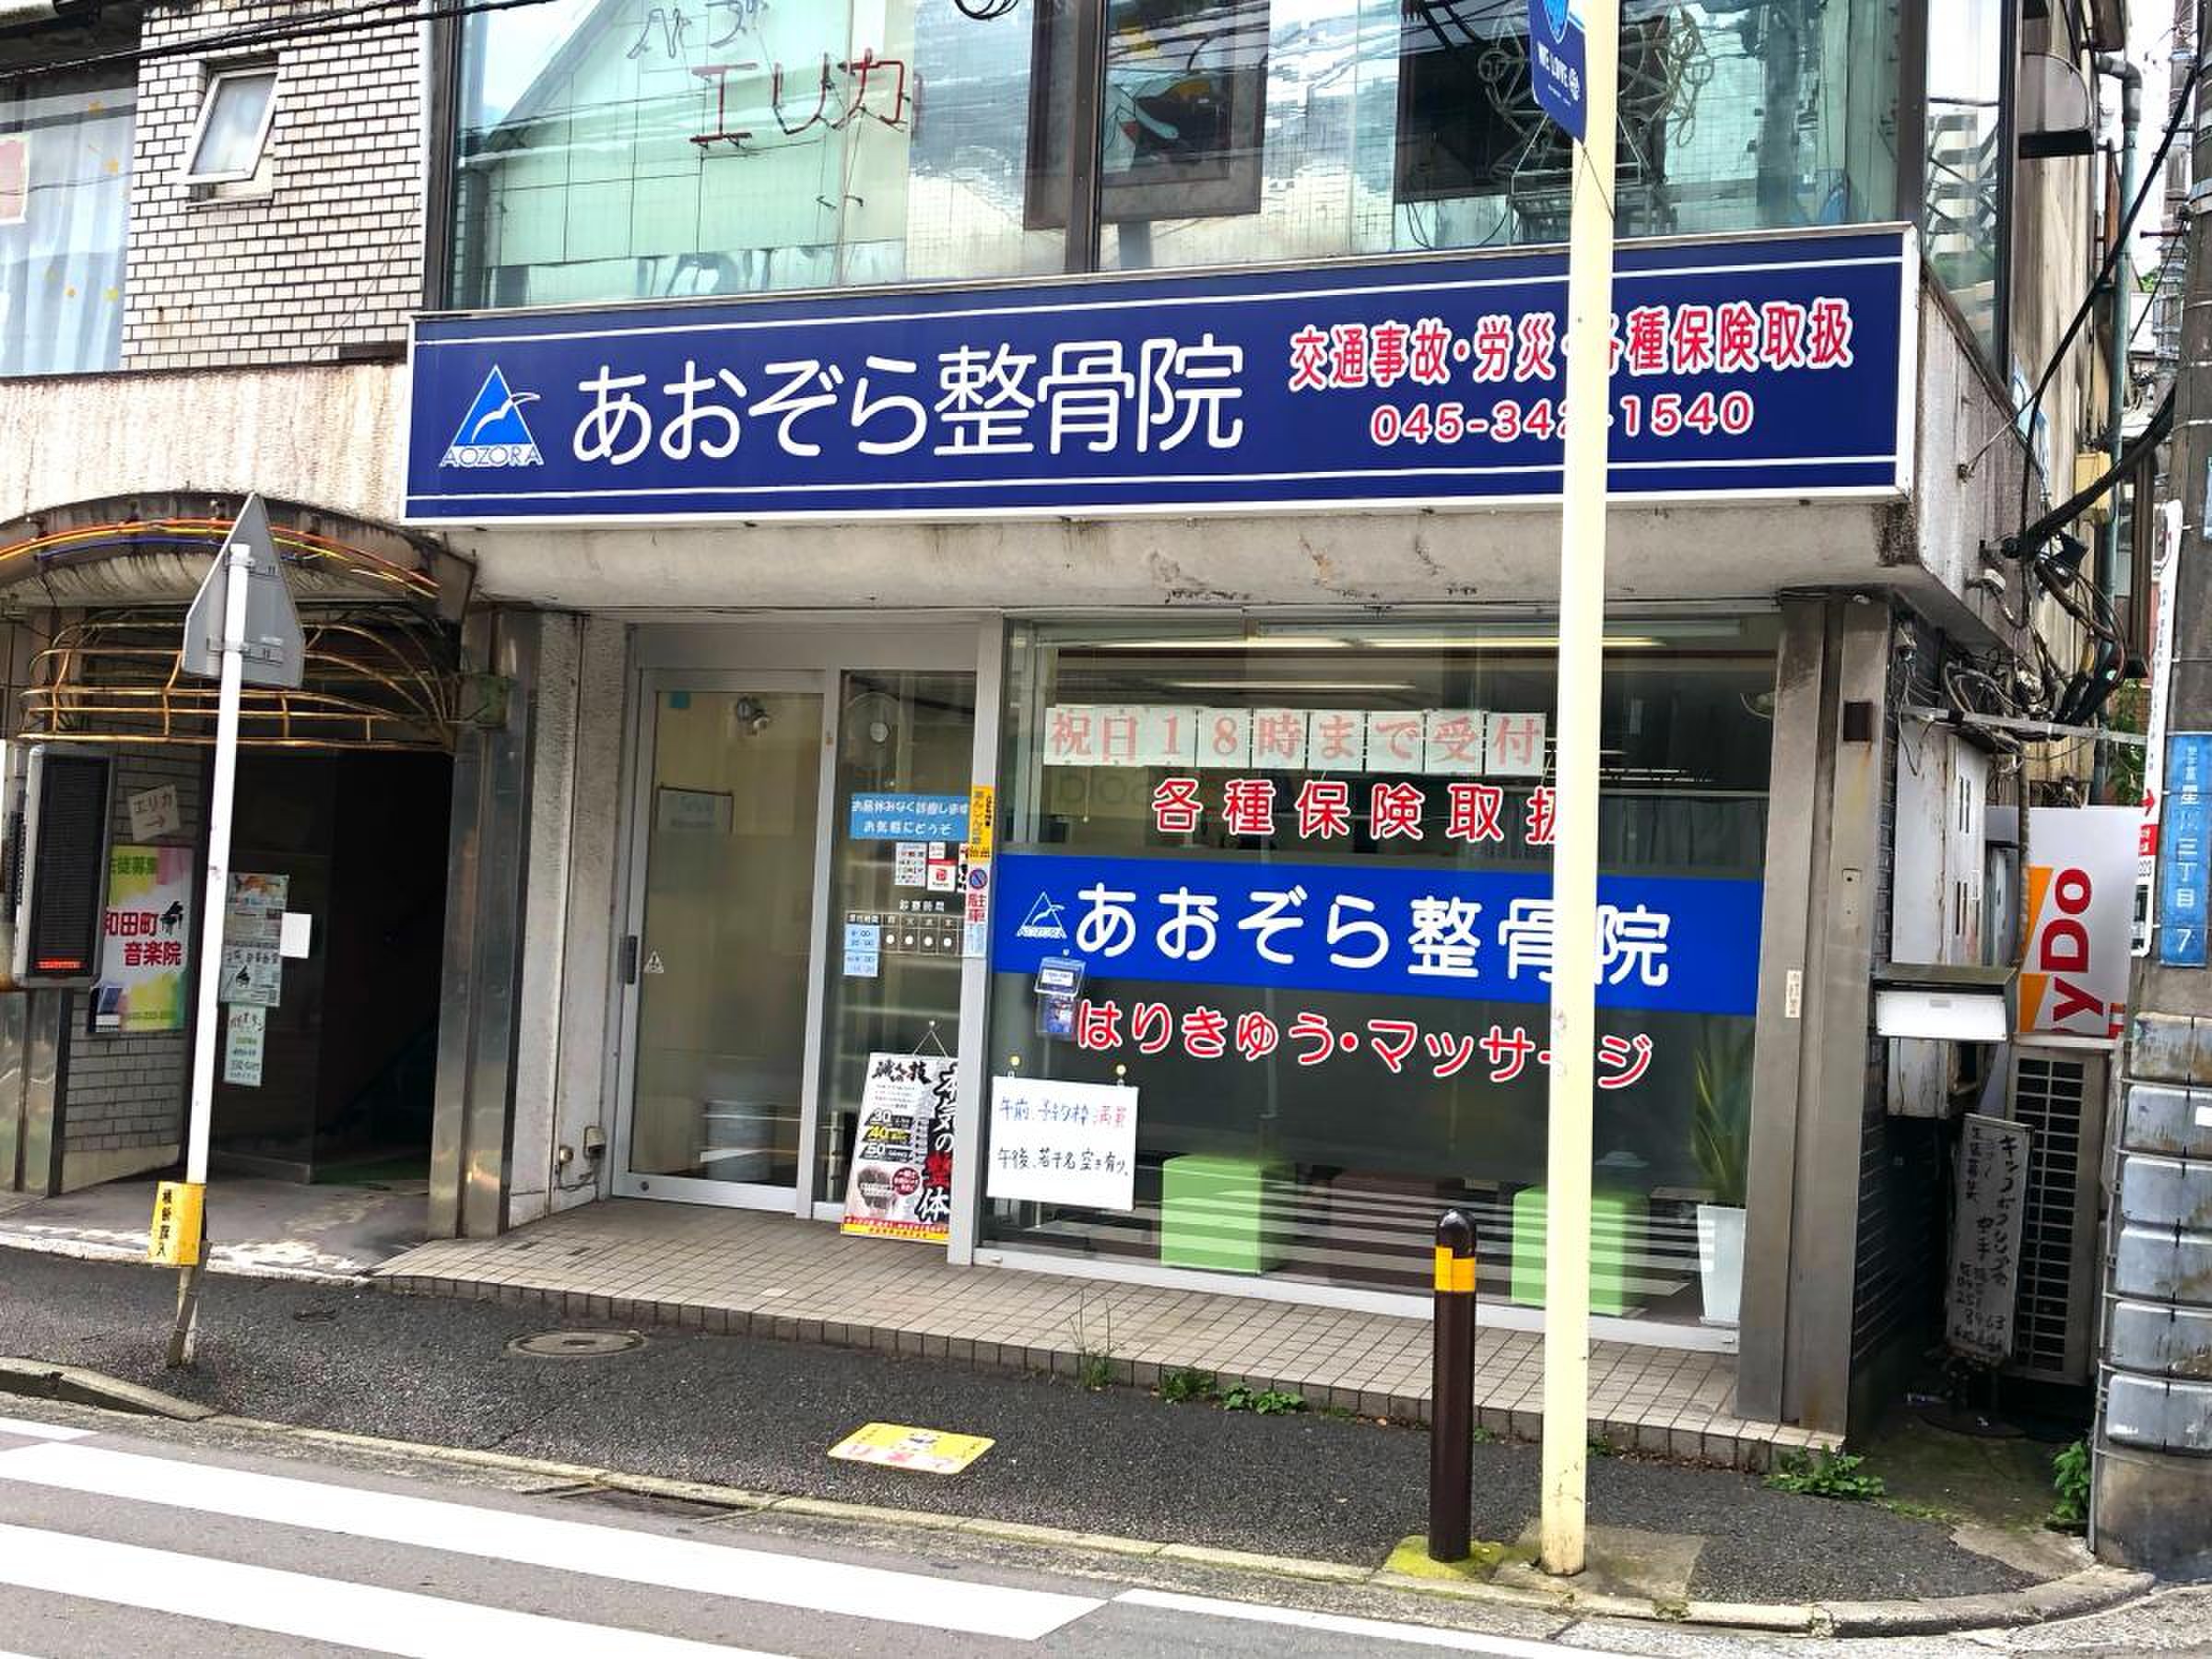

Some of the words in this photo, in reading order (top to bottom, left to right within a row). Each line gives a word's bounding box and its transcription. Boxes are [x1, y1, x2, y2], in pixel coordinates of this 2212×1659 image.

[690, 48, 908, 143] エリカ
[1289, 297, 1853, 392] 交通事故・労災種保険取扱
[573, 333, 1243, 465] あおぞら整骨院
[1371, 392, 1753, 445] 045-341540
[439, 445, 544, 467] AOZORA
[1052, 712, 1542, 766] 祝日18時まで受付
[103, 912, 159, 936] 和田町
[124, 941, 182, 966] 音楽院
[1076, 882, 1671, 985] あおぞら整骨院
[2040, 868, 2104, 1032] yDo
[2177, 928, 2193, 953] 7
[1077, 1000, 1653, 1088] はりきゅう・マッサジ
